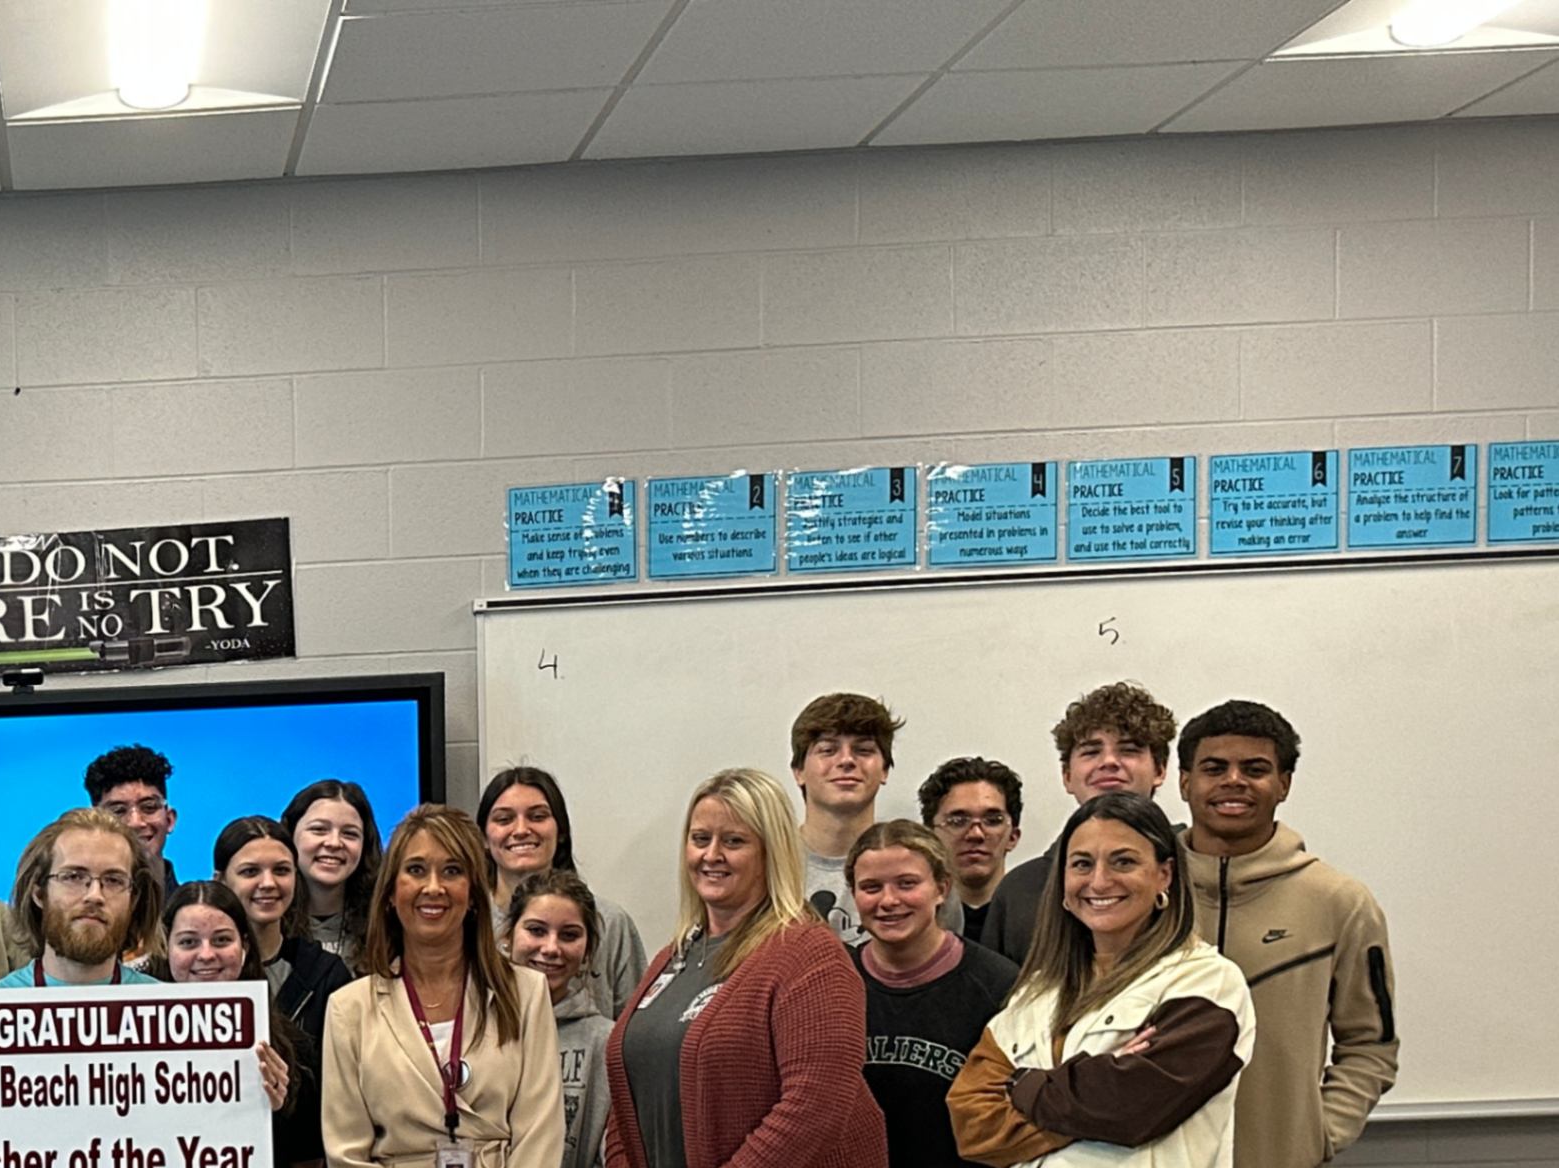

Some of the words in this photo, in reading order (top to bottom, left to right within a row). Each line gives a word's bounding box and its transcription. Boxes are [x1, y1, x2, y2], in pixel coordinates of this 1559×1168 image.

[1354, 450, 1437, 467] MATHEMATICAL
[1494, 445, 1559, 461] MATHEMATI
[1074, 462, 1155, 479] MATHEMATICAL
[1214, 457, 1296, 474] MATHEMATICAL
[1314, 462, 1324, 480] 6
[1453, 456, 1462, 474] 7
[1493, 465, 1544, 480] PRACTICE
[1034, 474, 1043, 491] 4
[1172, 468, 1180, 486] 5
[1214, 477, 1265, 493] PRACTICE
[1353, 471, 1405, 486] PRACTICE
[753, 486, 761, 503] 2
[892, 479, 901, 496] 3
[1073, 483, 1123, 498] PRACTICE
[1494, 488, 1513, 500] Look
[1516, 487, 1531, 498] for
[1534, 487, 1559, 501] patte
[935, 489, 985, 504] PRACTICE
[1393, 493, 1409, 503] the
[1411, 492, 1456, 503] structure
[1459, 490, 1468, 501] of
[1082, 506, 1109, 518] Decide
[1113, 504, 1128, 516] the
[1130, 504, 1149, 515] best
[1154, 503, 1170, 514] tool
[1173, 503, 1183, 513] to
[1223, 501, 1238, 515] Try
[1241, 500, 1250, 511] to
[1254, 499, 1265, 510] be
[1311, 497, 1327, 507] but
[1513, 505, 1554, 520] patterns
[514, 509, 564, 525] PRACTICE
[886, 513, 903, 524] and
[957, 511, 982, 521] Model
[985, 509, 1031, 520] situations
[1216, 520, 1243, 530] revise
[1246, 518, 1266, 531] your
[1270, 515, 1306, 529] thinking
[1309, 514, 1333, 525] after
[1354, 514, 1360, 523] a
[1363, 511, 1398, 525] problem
[1402, 510, 1411, 521] to
[1414, 509, 1432, 524] help
[1435, 508, 1453, 520] find
[1455, 509, 1470, 519] the
[659, 533, 673, 544] Use
[718, 531, 727, 541] to
[730, 528, 766, 540] describe
[939, 528, 983, 543] presented
[986, 528, 995, 538] in
[998, 526, 1036, 541] problems
[1040, 526, 1048, 536] in
[1082, 525, 1097, 535] use
[1101, 524, 1109, 534] to
[1113, 522, 1134, 534] solve
[1137, 523, 1143, 532] a
[1396, 529, 1428, 539] answer
[1532, 522, 1559, 536] proble
[548, 532, 570, 542] sense
[836, 534, 844, 544] to
[848, 534, 860, 544] see
[864, 532, 872, 542] if
[874, 531, 898, 541] other
[1074, 541, 1091, 552] and
[1094, 541, 1109, 552] use
[1112, 539, 1127, 551] the
[1130, 539, 1147, 550] tool
[1149, 537, 1190, 551] correctly
[1238, 534, 1270, 547] making
[1273, 534, 1285, 544] an
[1288, 534, 1311, 544] error
[104, 535, 241, 580] NOT.
[527, 551, 543, 560] and
[546, 550, 565, 562] keep
[599, 546, 620, 556] even
[708, 548, 753, 558] situations
[835, 551, 858, 561] ideas
[861, 551, 876, 560] are
[879, 548, 906, 562] logical
[959, 545, 1003, 557] numerous
[1006, 545, 1028, 557] ways
[517, 569, 539, 578] when
[542, 567, 562, 577] they
[565, 566, 579, 575] are
[79, 590, 115, 611] IS
[129, 579, 282, 635] TRY
[76, 613, 124, 640] NO
[0, 1064, 79, 1109] Beach
[88, 1062, 146, 1117] High
[155, 1059, 241, 1103] School
